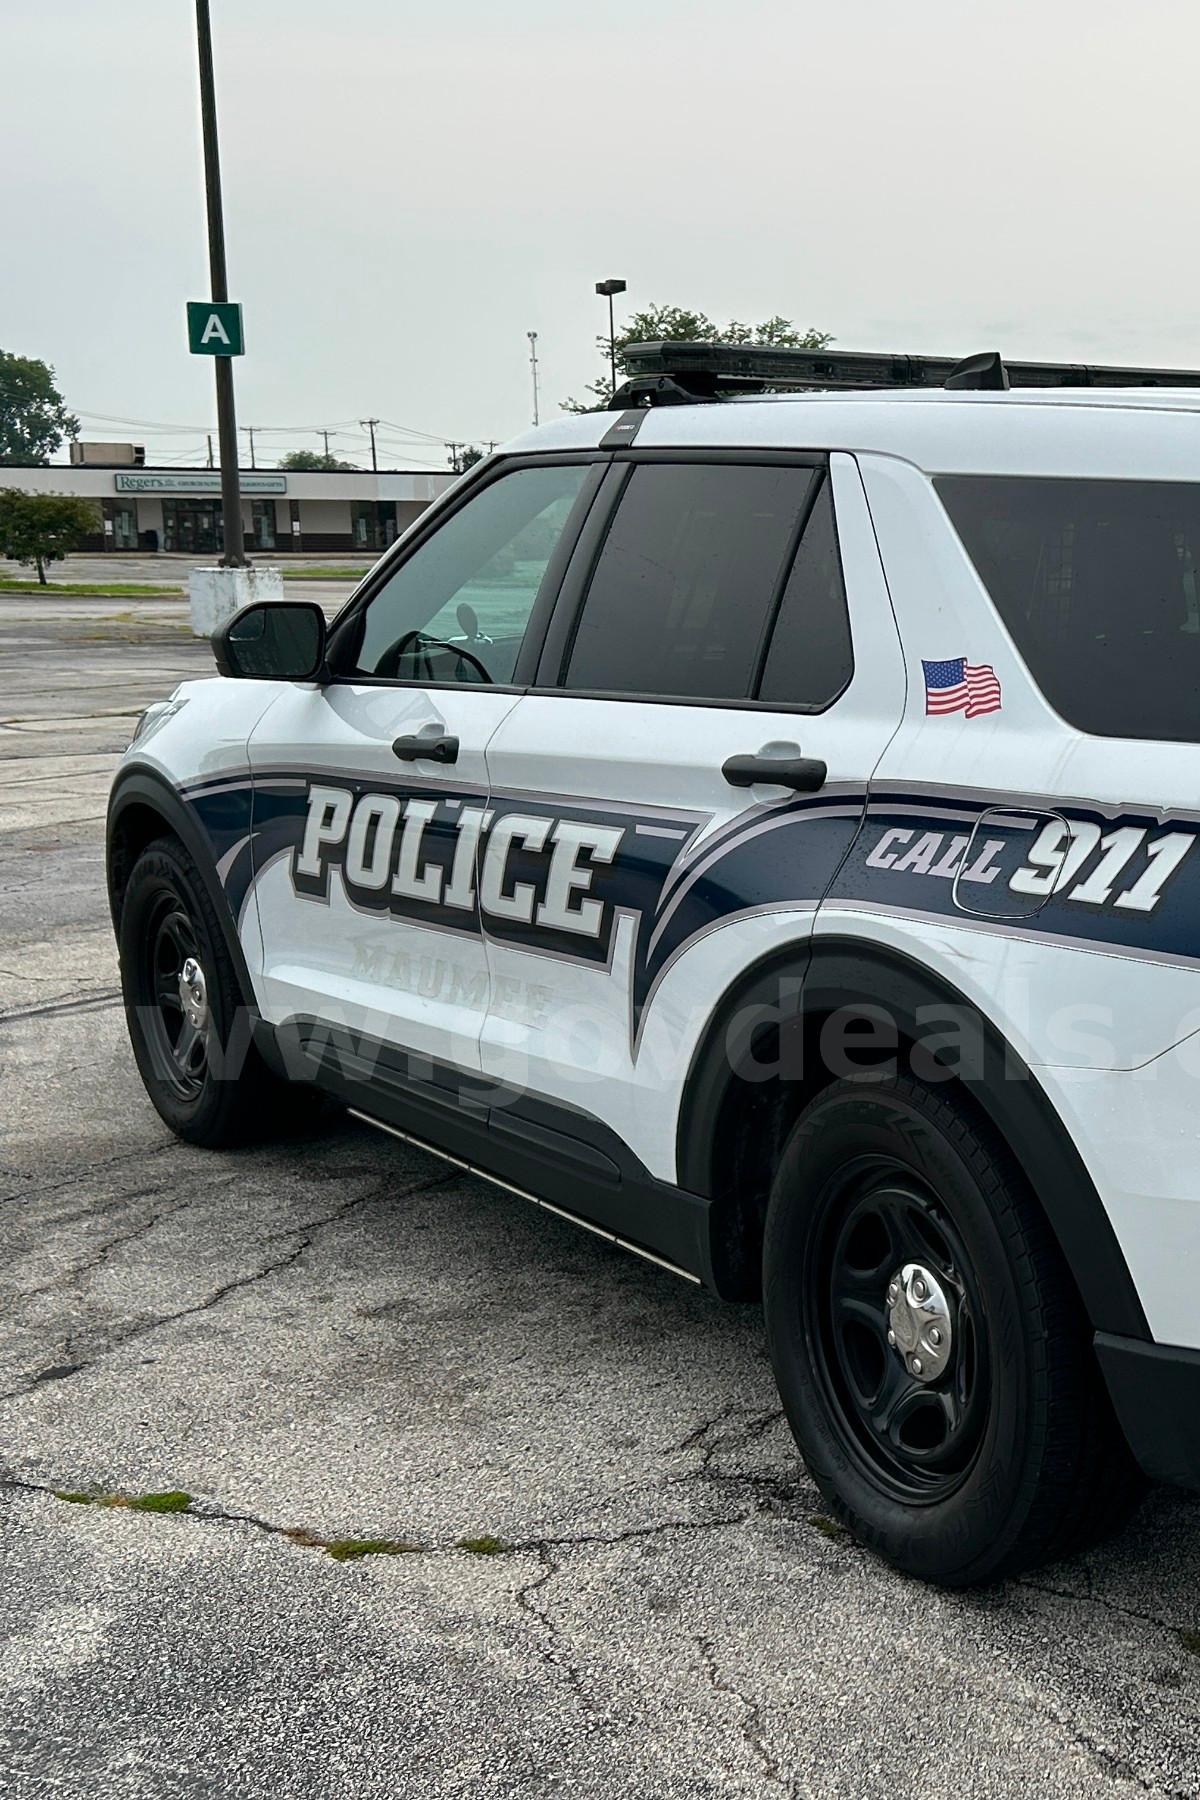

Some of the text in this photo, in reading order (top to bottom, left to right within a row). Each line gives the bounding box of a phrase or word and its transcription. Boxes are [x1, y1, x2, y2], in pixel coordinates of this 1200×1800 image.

[200, 313, 231, 345] A
[296, 784, 627, 938] POLICE
[866, 820, 1196, 912] CALL 911
